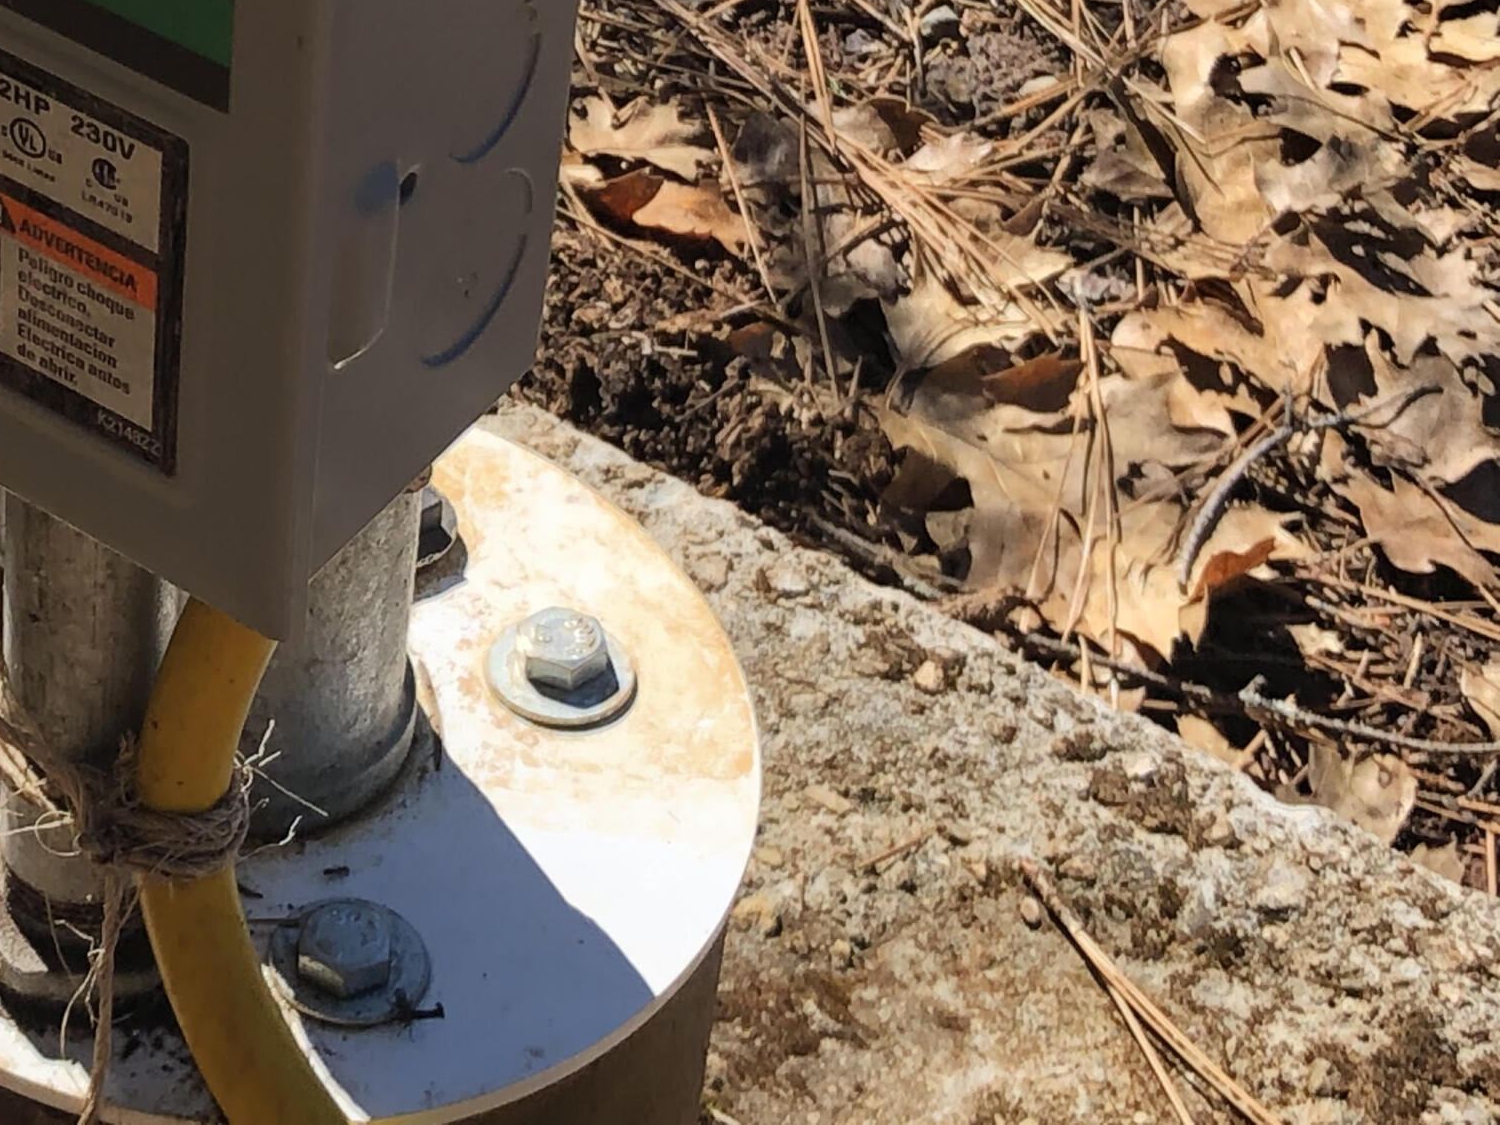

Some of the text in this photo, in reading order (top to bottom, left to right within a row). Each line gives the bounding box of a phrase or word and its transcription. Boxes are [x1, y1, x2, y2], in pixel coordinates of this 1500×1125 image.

[71, 114, 135, 161] 230V
[18, 247, 135, 322] Peligro choque
[19, 219, 138, 292] ADVERTENCIA
[17, 306, 118, 370] alimentacion
[18, 285, 116, 349] Desconectar
[16, 341, 36, 362] de
[16, 323, 131, 397] Electrica antes
